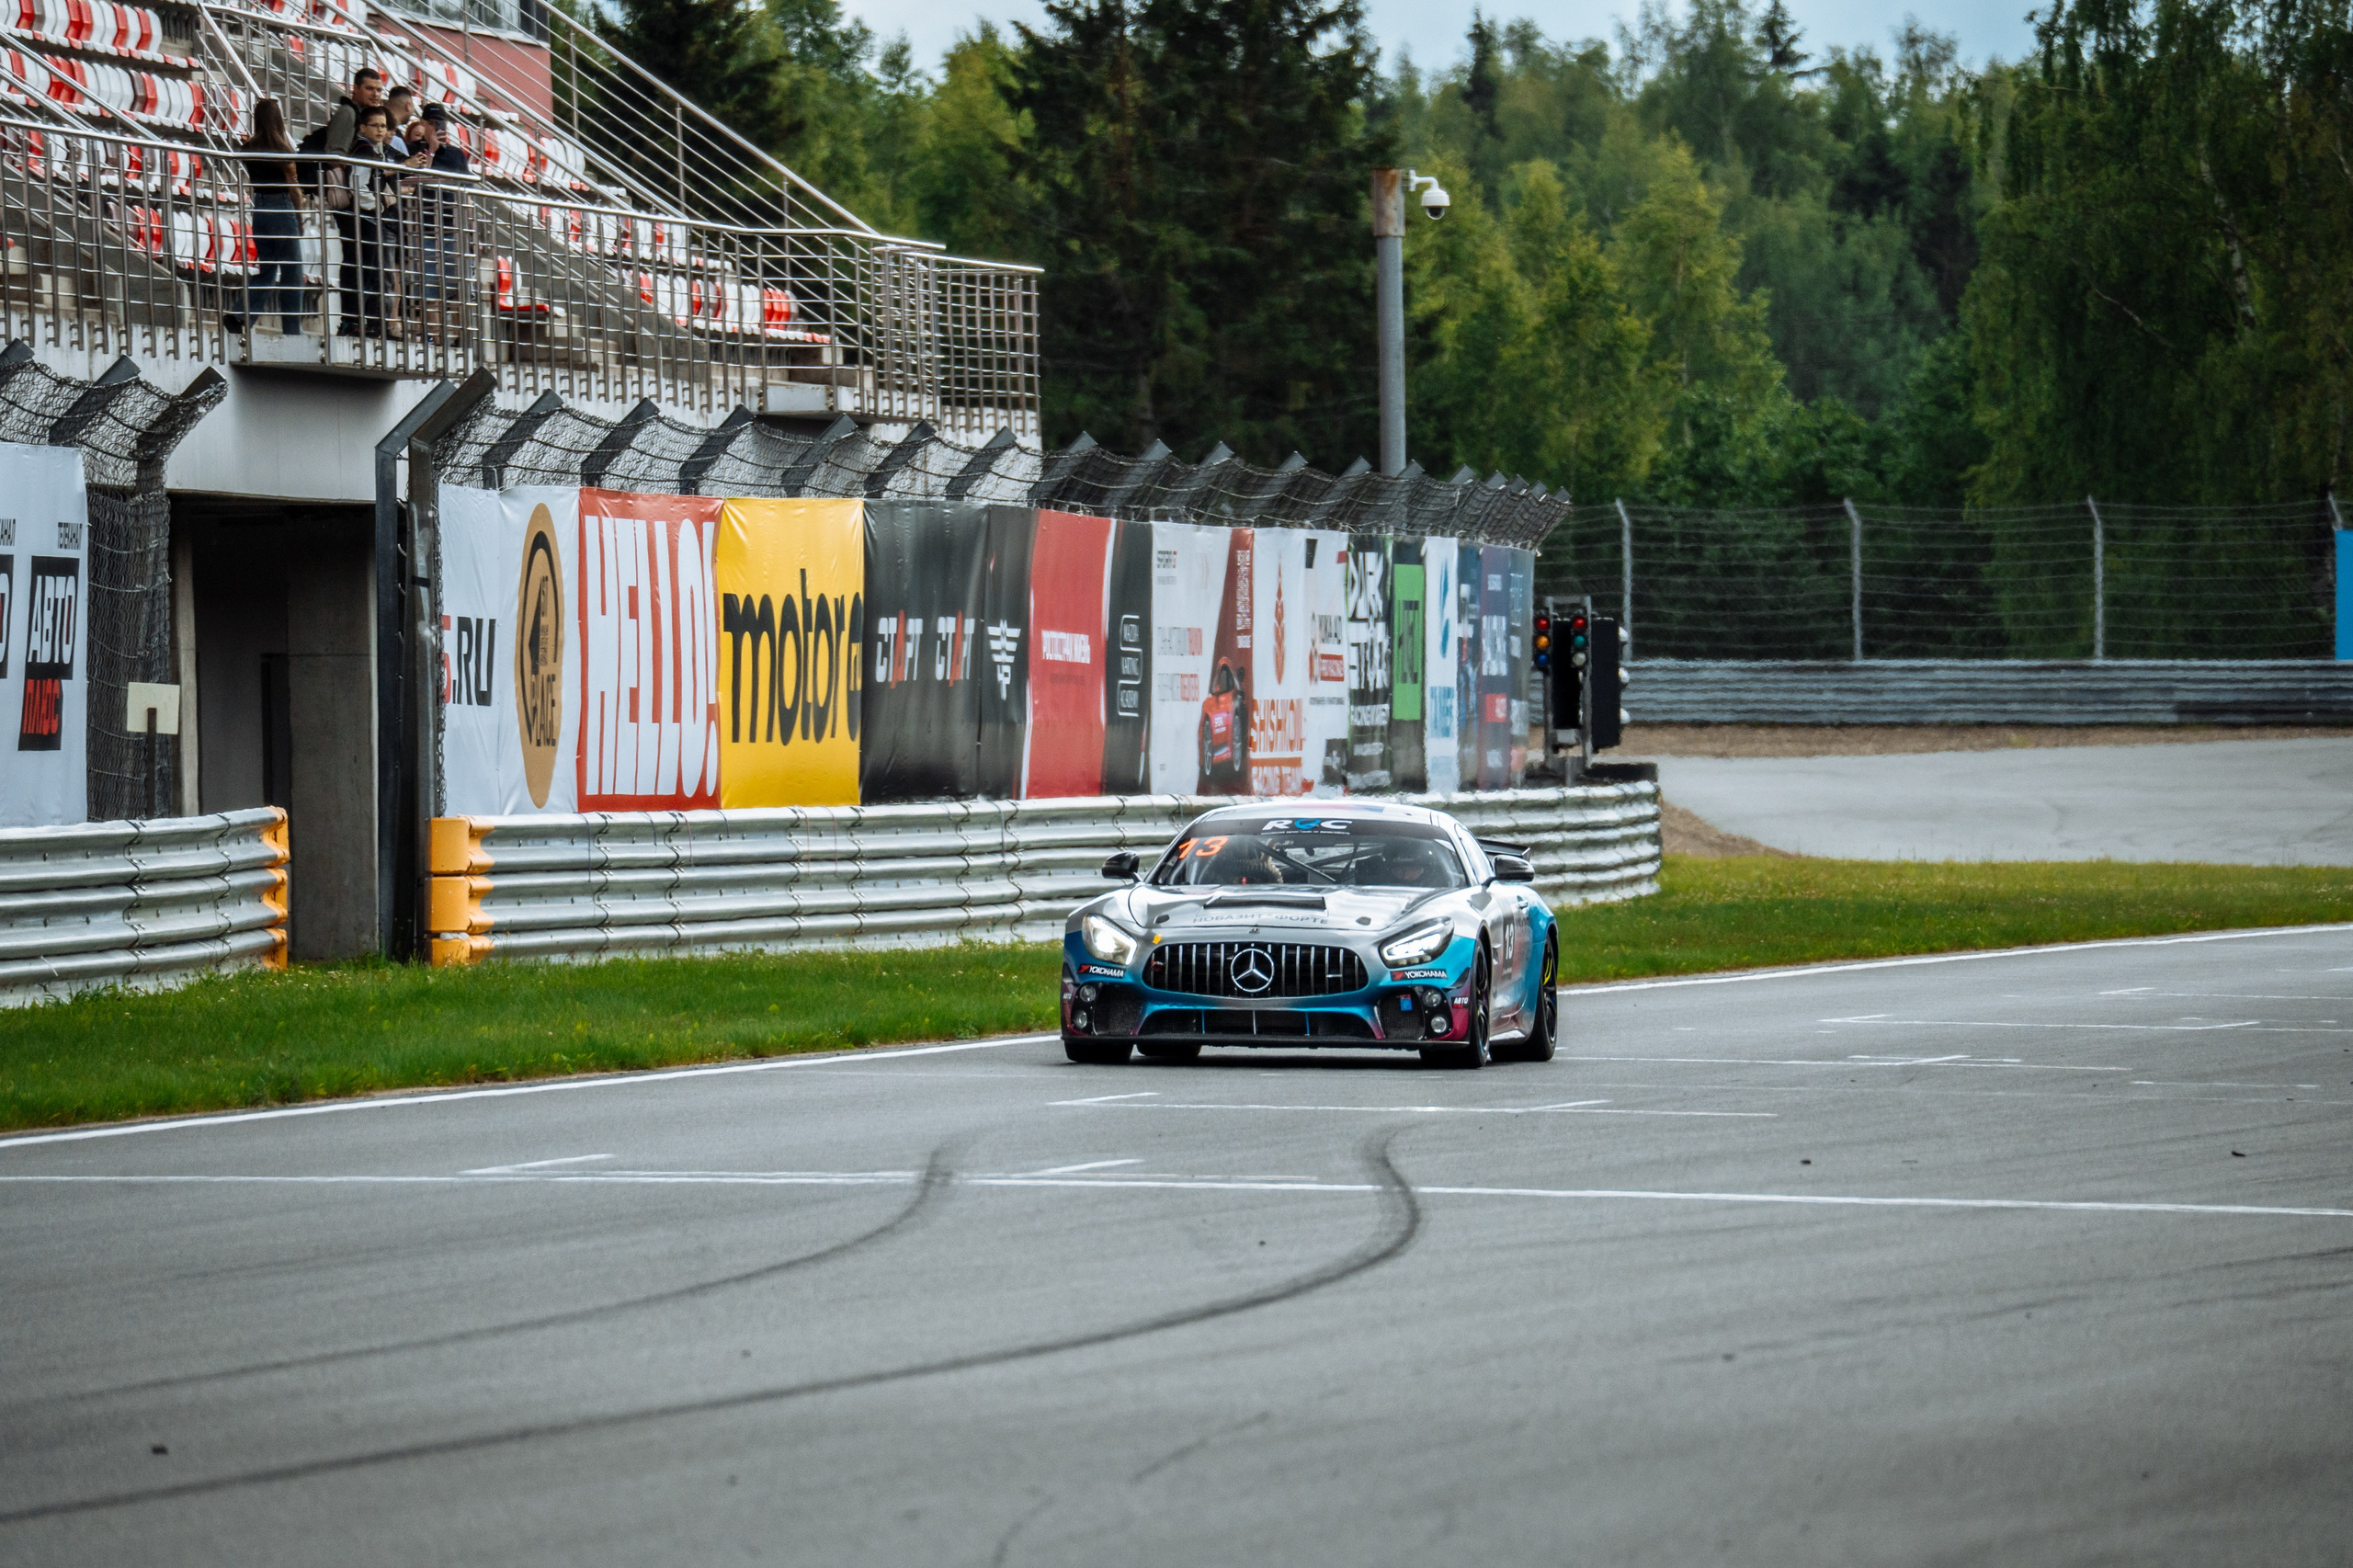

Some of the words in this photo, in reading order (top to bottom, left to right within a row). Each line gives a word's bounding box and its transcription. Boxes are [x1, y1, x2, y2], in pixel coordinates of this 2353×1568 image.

[27, 574, 76, 665] АВТО
[585, 515, 717, 799] HELLO!
[722, 568, 846, 746] motor
[22, 678, 61, 736] ПЛЮС
[1178, 836, 1229, 859] 13
[1275, 915, 1328, 925] ФОРТЕ
[1505, 923, 1515, 960] 13
[1089, 965, 1124, 977] YOKOHAMA
[1404, 970, 1448, 979] YOKOHAMA
